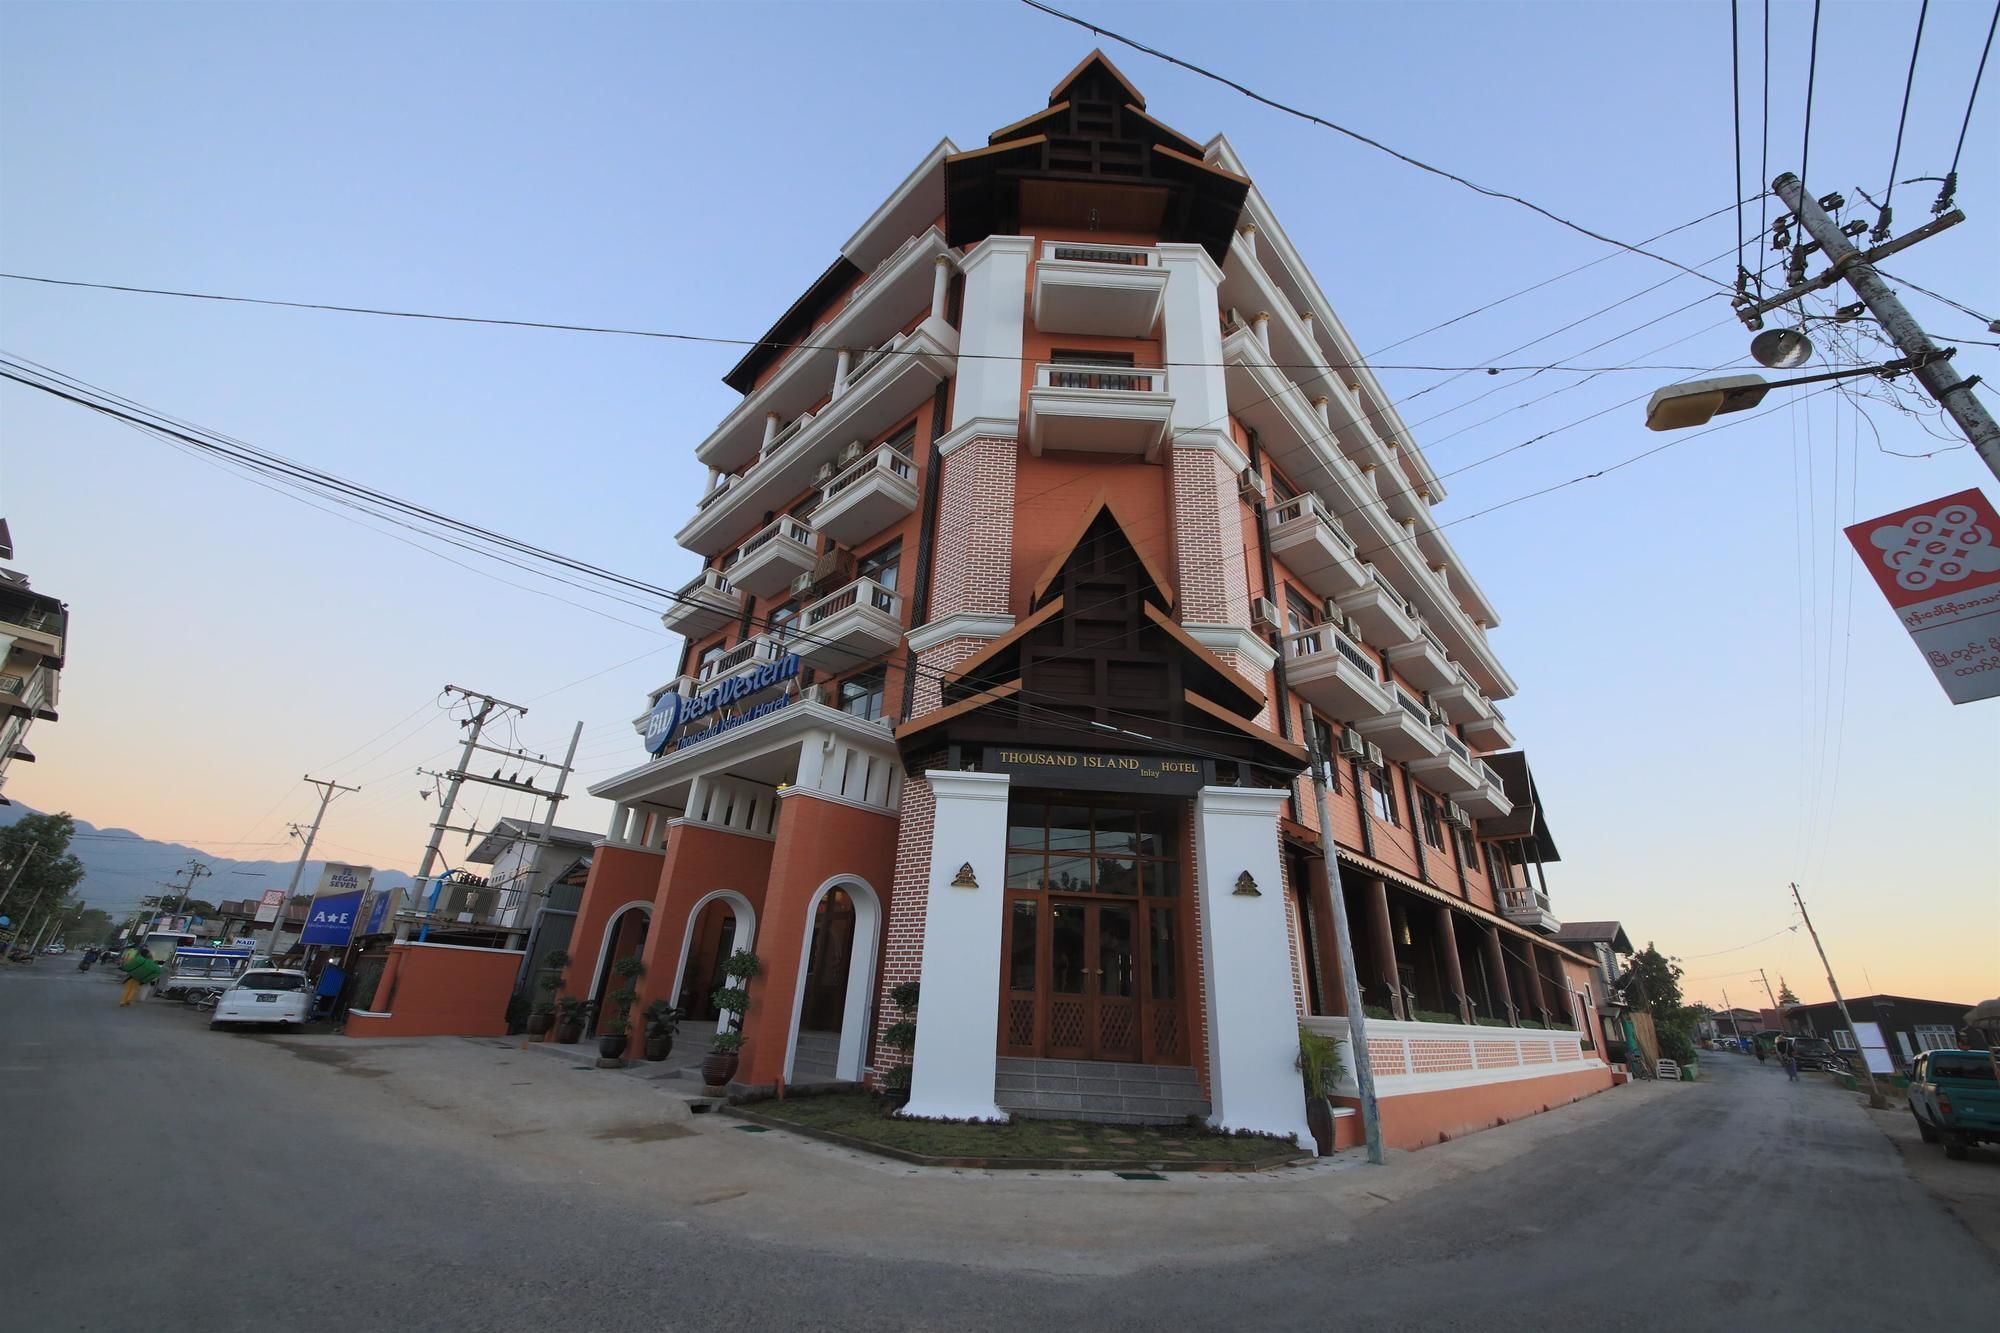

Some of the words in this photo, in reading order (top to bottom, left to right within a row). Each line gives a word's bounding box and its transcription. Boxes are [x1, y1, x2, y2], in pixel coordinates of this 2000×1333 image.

[681, 688, 719, 725] Best
[718, 654, 800, 706] Western
[677, 721, 718, 750] Thousand
[721, 709, 752, 732] Island
[754, 693, 791, 720] Hotel
[1000, 751, 1077, 767] THOUSAND
[1083, 756, 1139, 770] ISLAND
[1141, 768, 1160, 778] Inlay
[1161, 762, 1199, 773] HOTEL
[329, 881, 358, 889] SEVEN
[331, 874, 358, 883] REGAL
